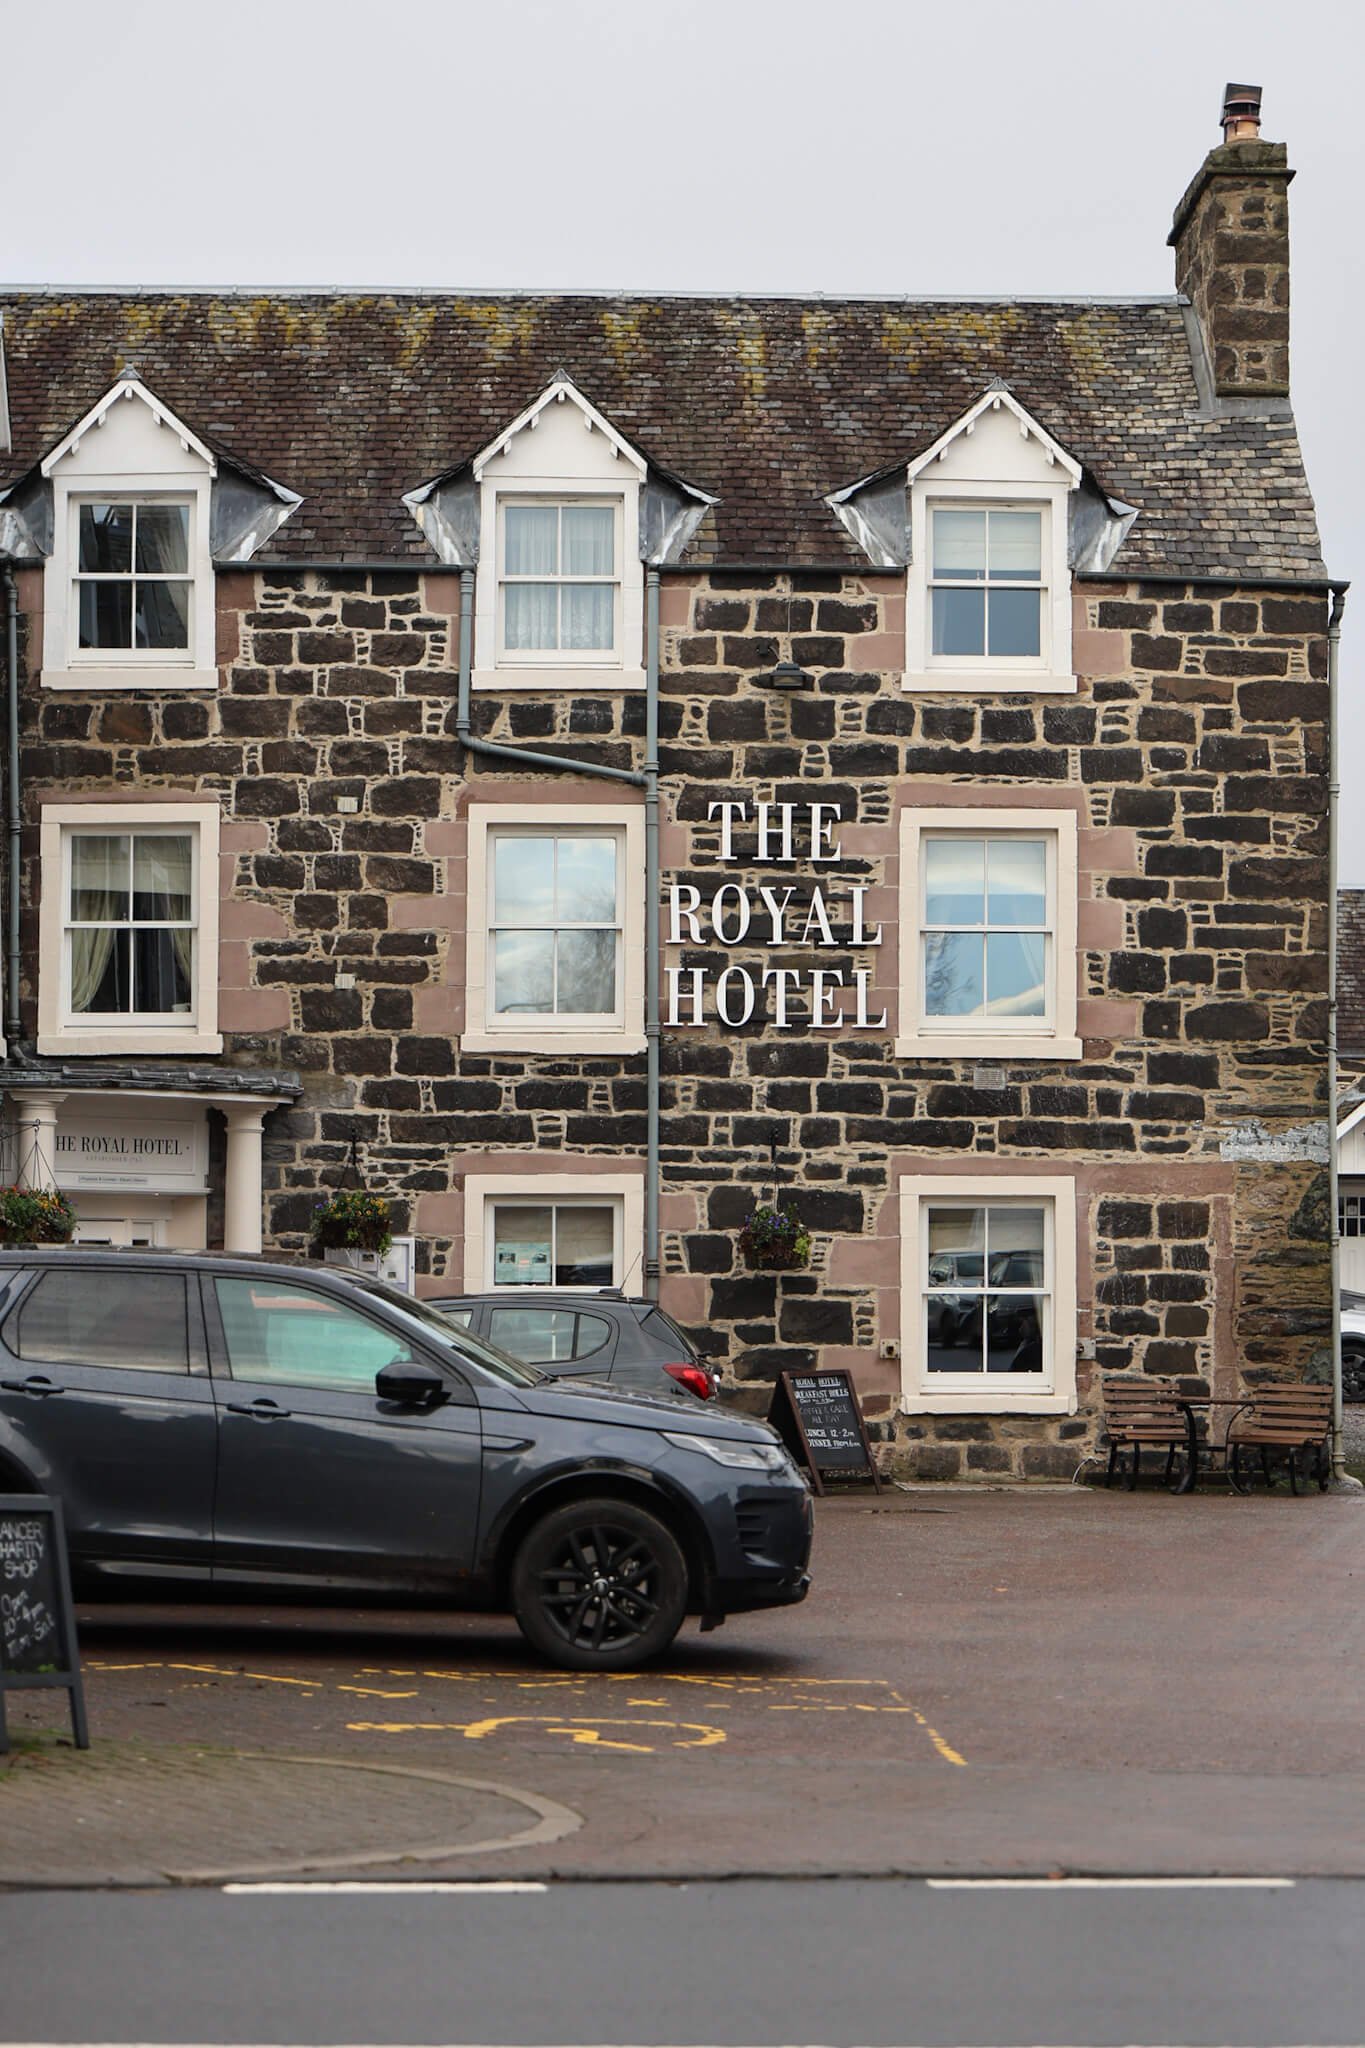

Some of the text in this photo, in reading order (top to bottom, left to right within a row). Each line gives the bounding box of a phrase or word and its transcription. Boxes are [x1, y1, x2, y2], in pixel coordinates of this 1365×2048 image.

[708, 802, 841, 861] THE
[665, 884, 882, 946] ROYAL
[663, 966, 887, 1029] HOTEL
[55, 1135, 183, 1156] HE ROYAL HOTEL
[0, 1521, 43, 1540] ANCER
[0, 1540, 44, 1559] HARITY
[4, 1560, 39, 1579] SHOP
